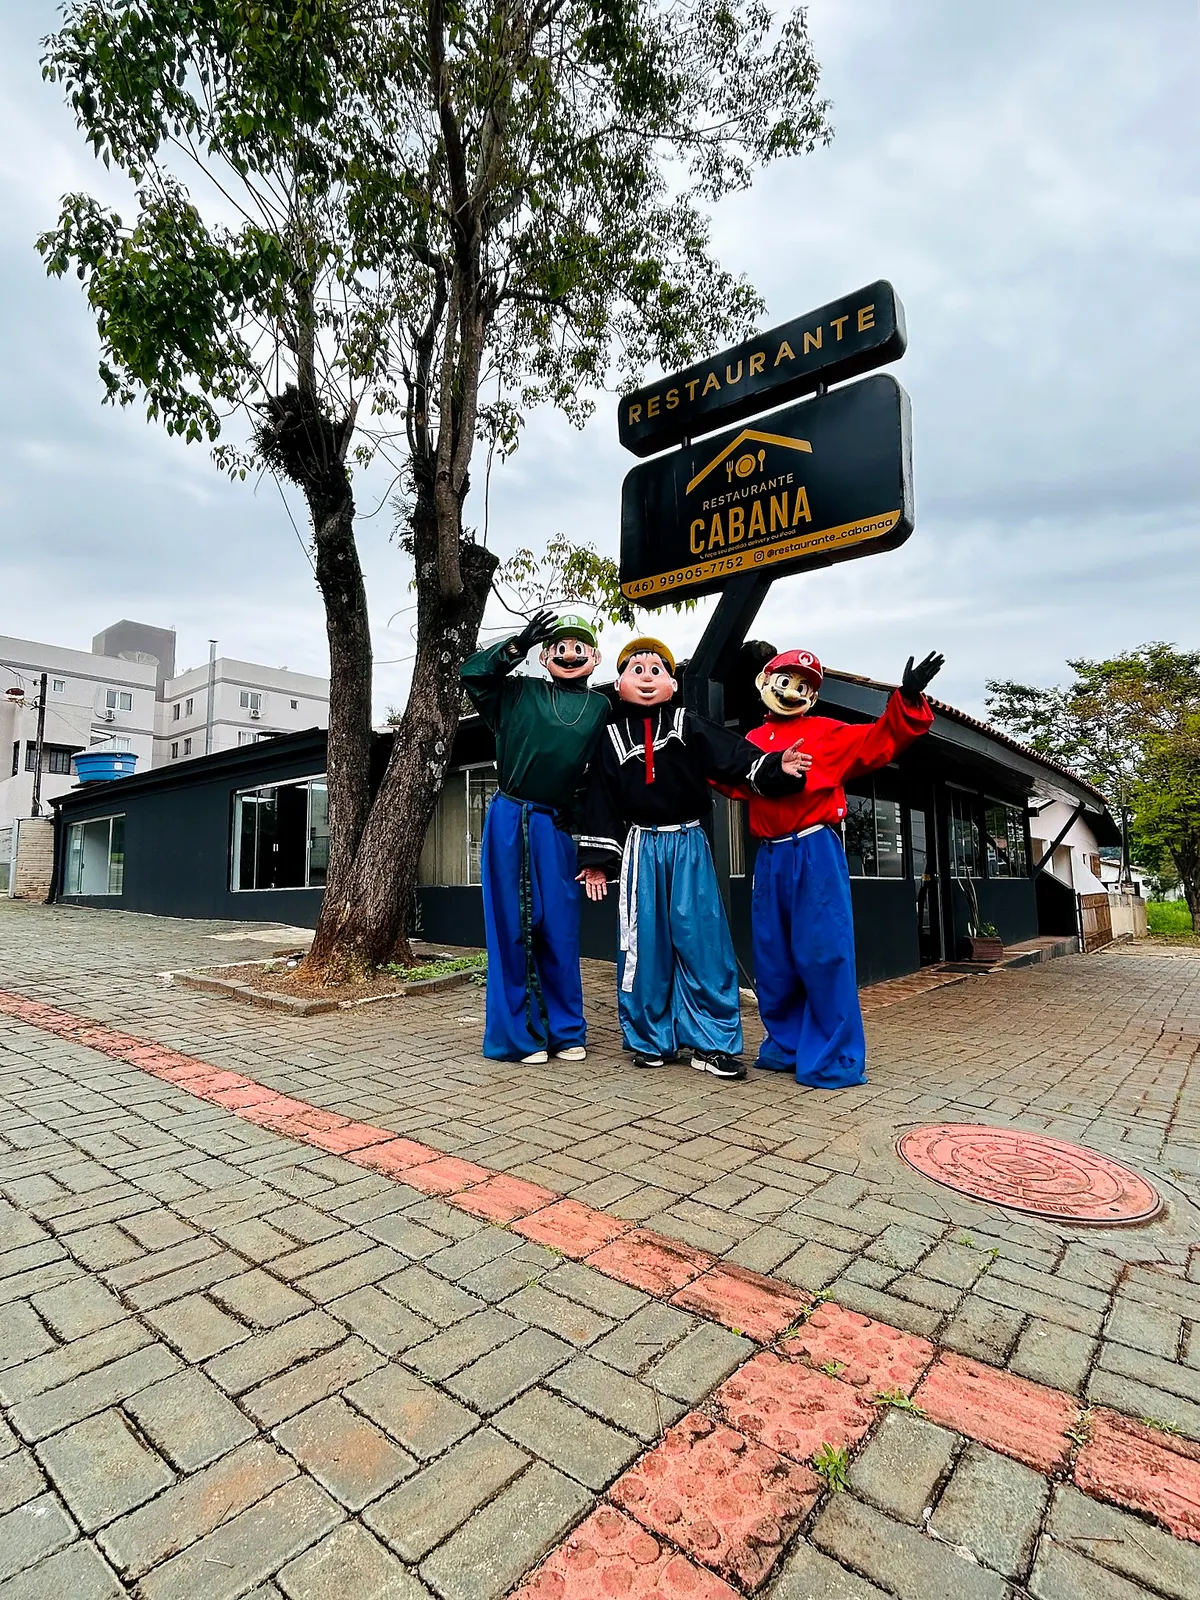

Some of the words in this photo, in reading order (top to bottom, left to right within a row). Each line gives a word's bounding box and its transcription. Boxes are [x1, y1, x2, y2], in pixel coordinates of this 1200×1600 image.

[628, 304, 875, 425] RESTAURANTE
[702, 472, 794, 511] RESTAURANTE
[690, 486, 812, 554] CABANA
[766, 518, 893, 558] @restaurante_cabanaa
[747, 536, 770, 547] delivery
[628, 580, 654, 594] (46)
[660, 556, 743, 587] 99905-7752
